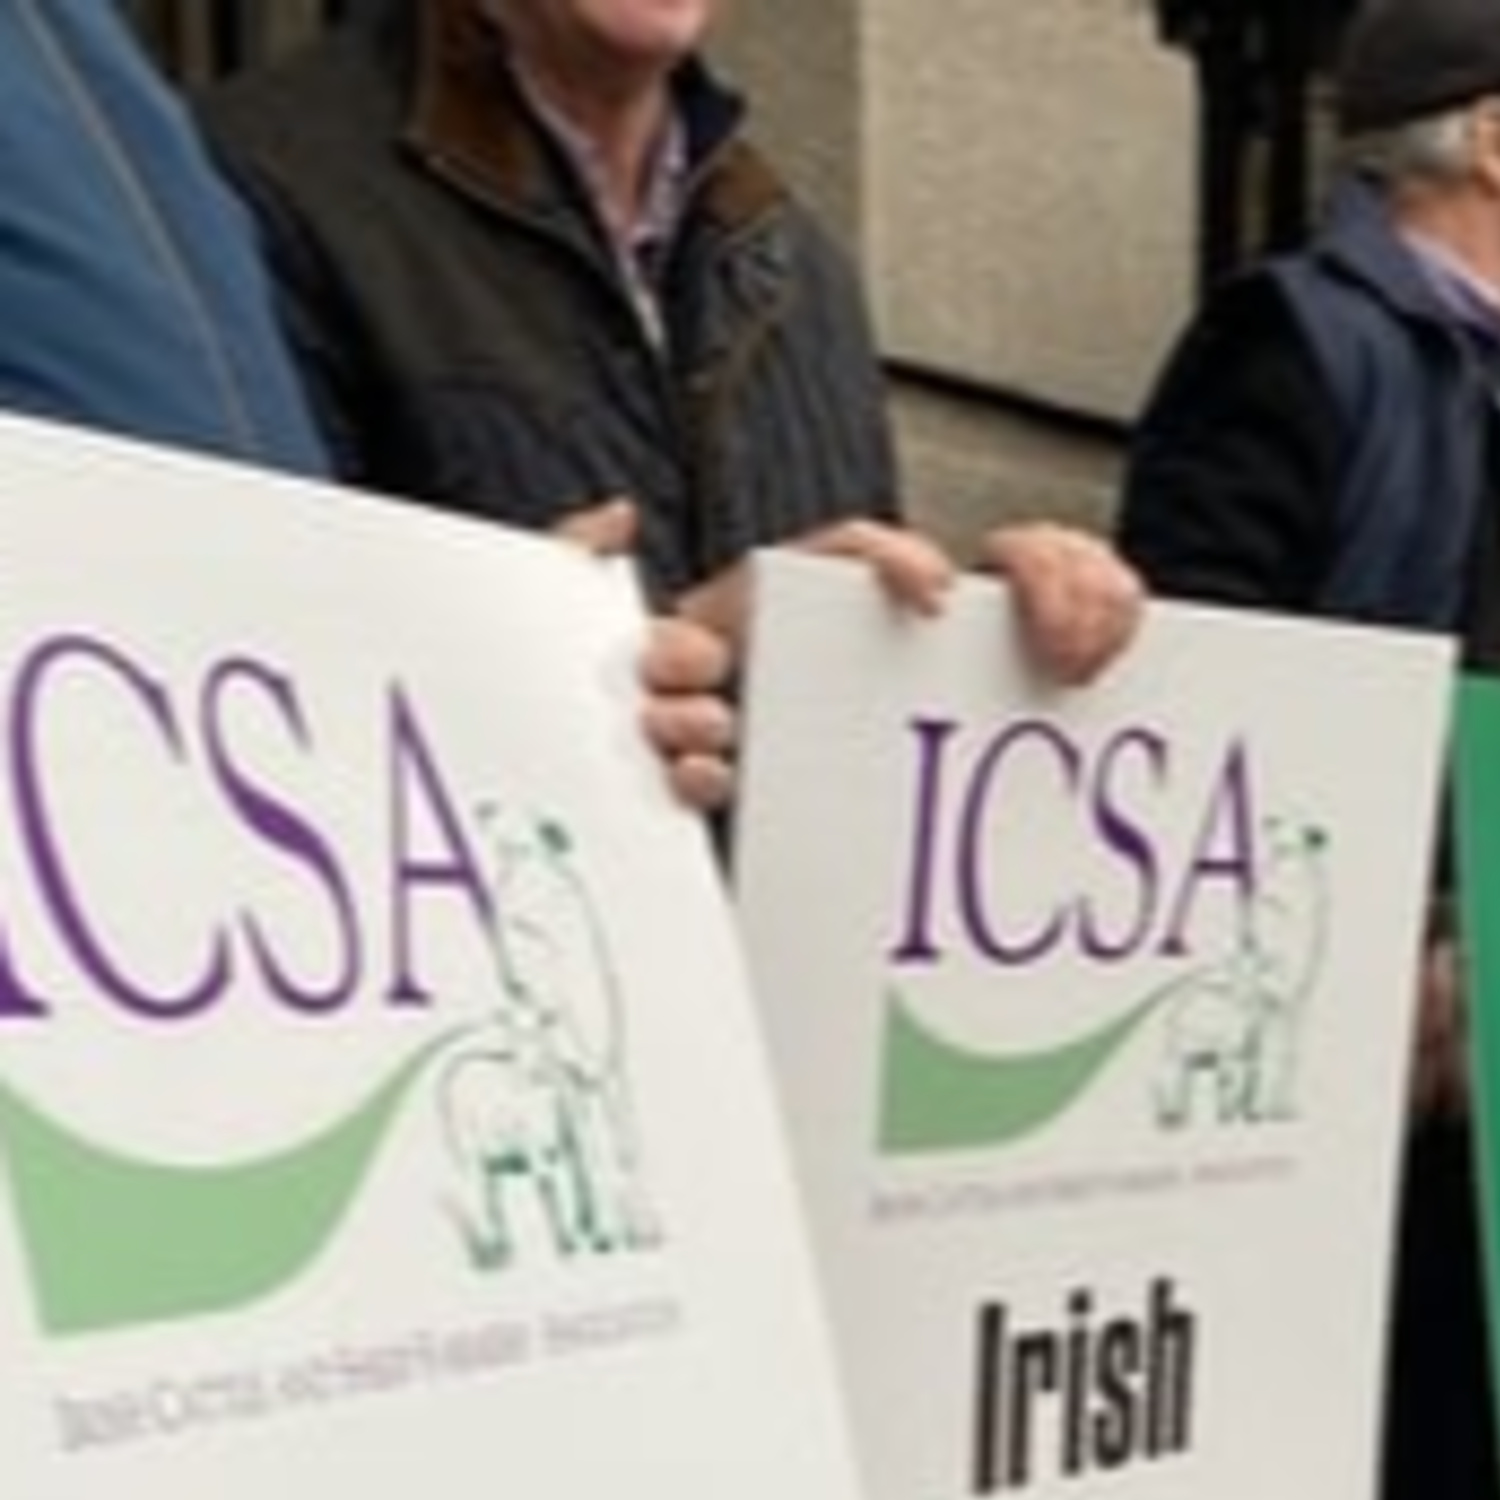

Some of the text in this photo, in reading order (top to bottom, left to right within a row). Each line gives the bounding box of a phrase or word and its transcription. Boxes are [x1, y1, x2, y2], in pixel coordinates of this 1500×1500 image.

[0, 634, 530, 1020] CSA
[886, 716, 1258, 966] ICSA
[971, 1276, 1194, 1497] Irish
